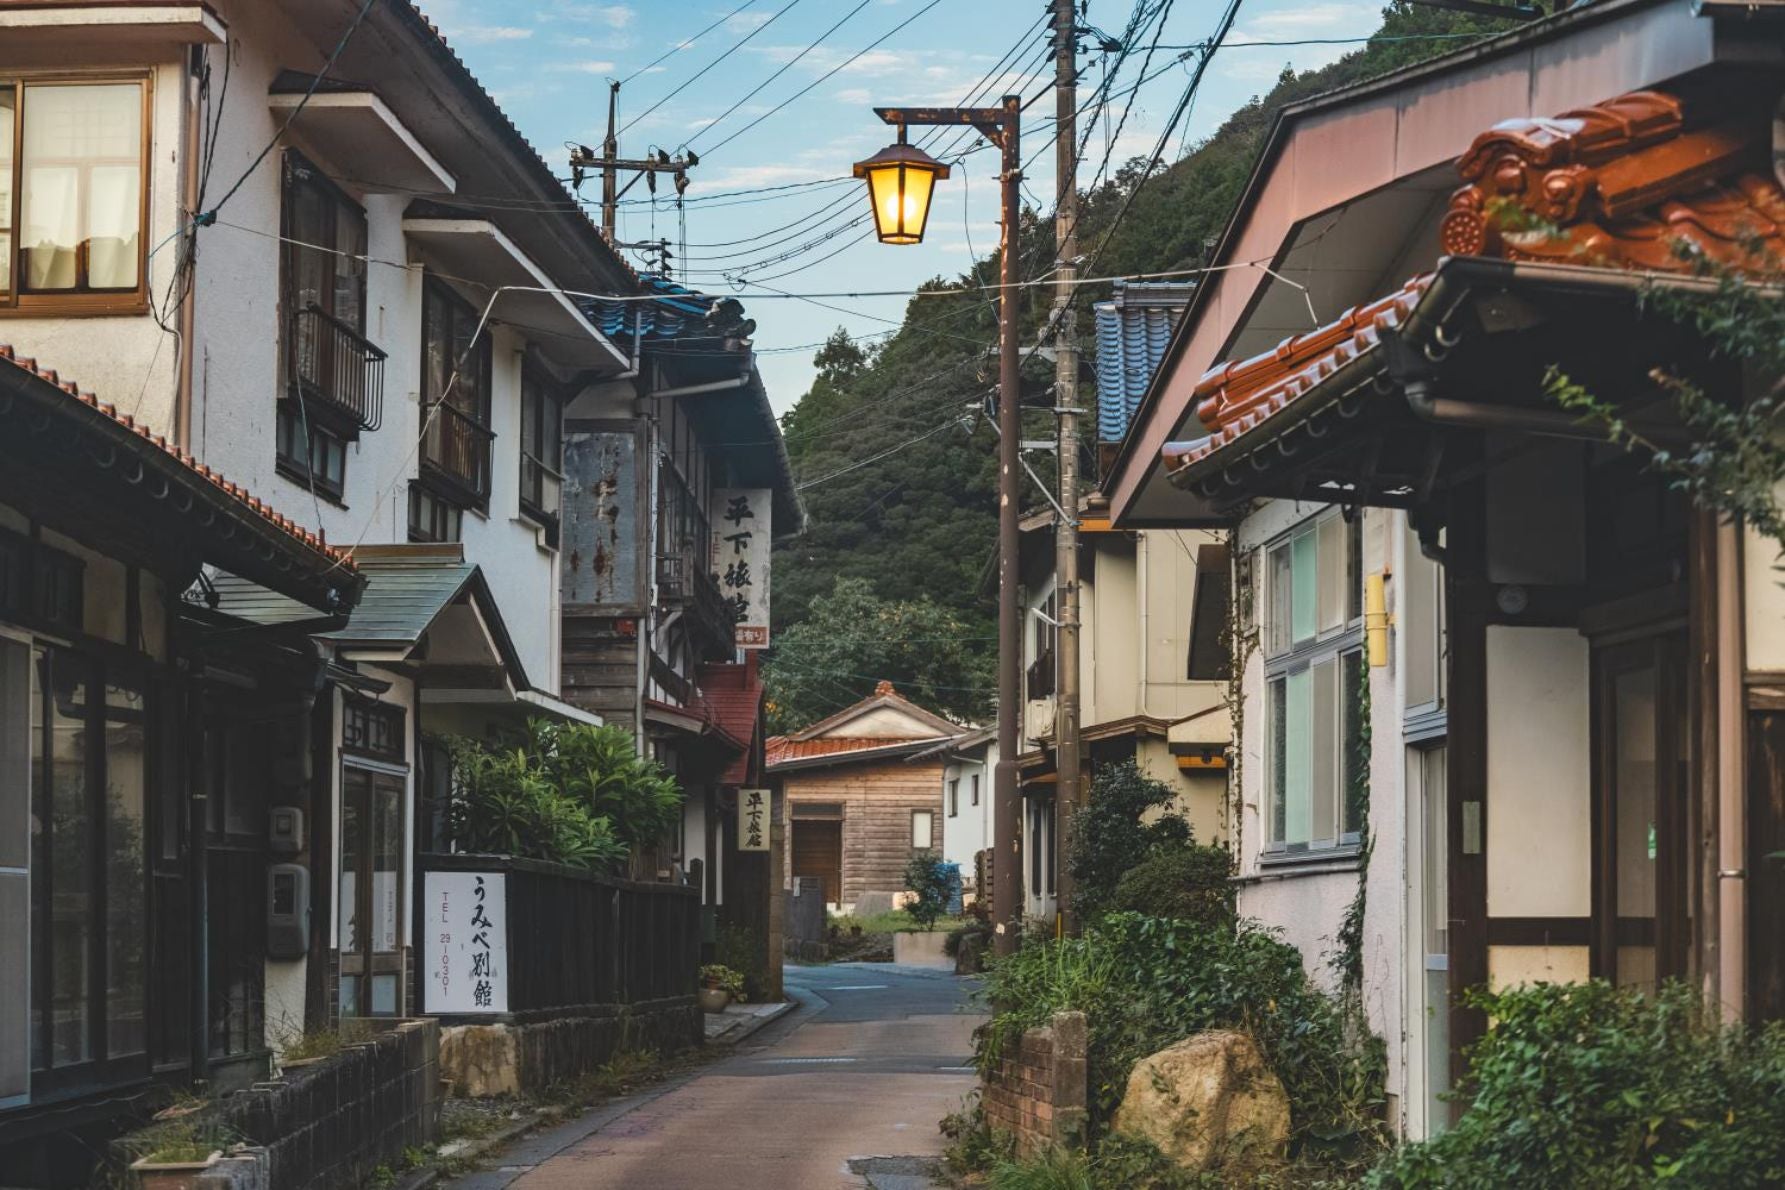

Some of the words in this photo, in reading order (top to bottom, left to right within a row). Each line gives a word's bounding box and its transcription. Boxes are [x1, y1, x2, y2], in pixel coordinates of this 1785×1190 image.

[471, 876, 493, 1007] うみべ別館
